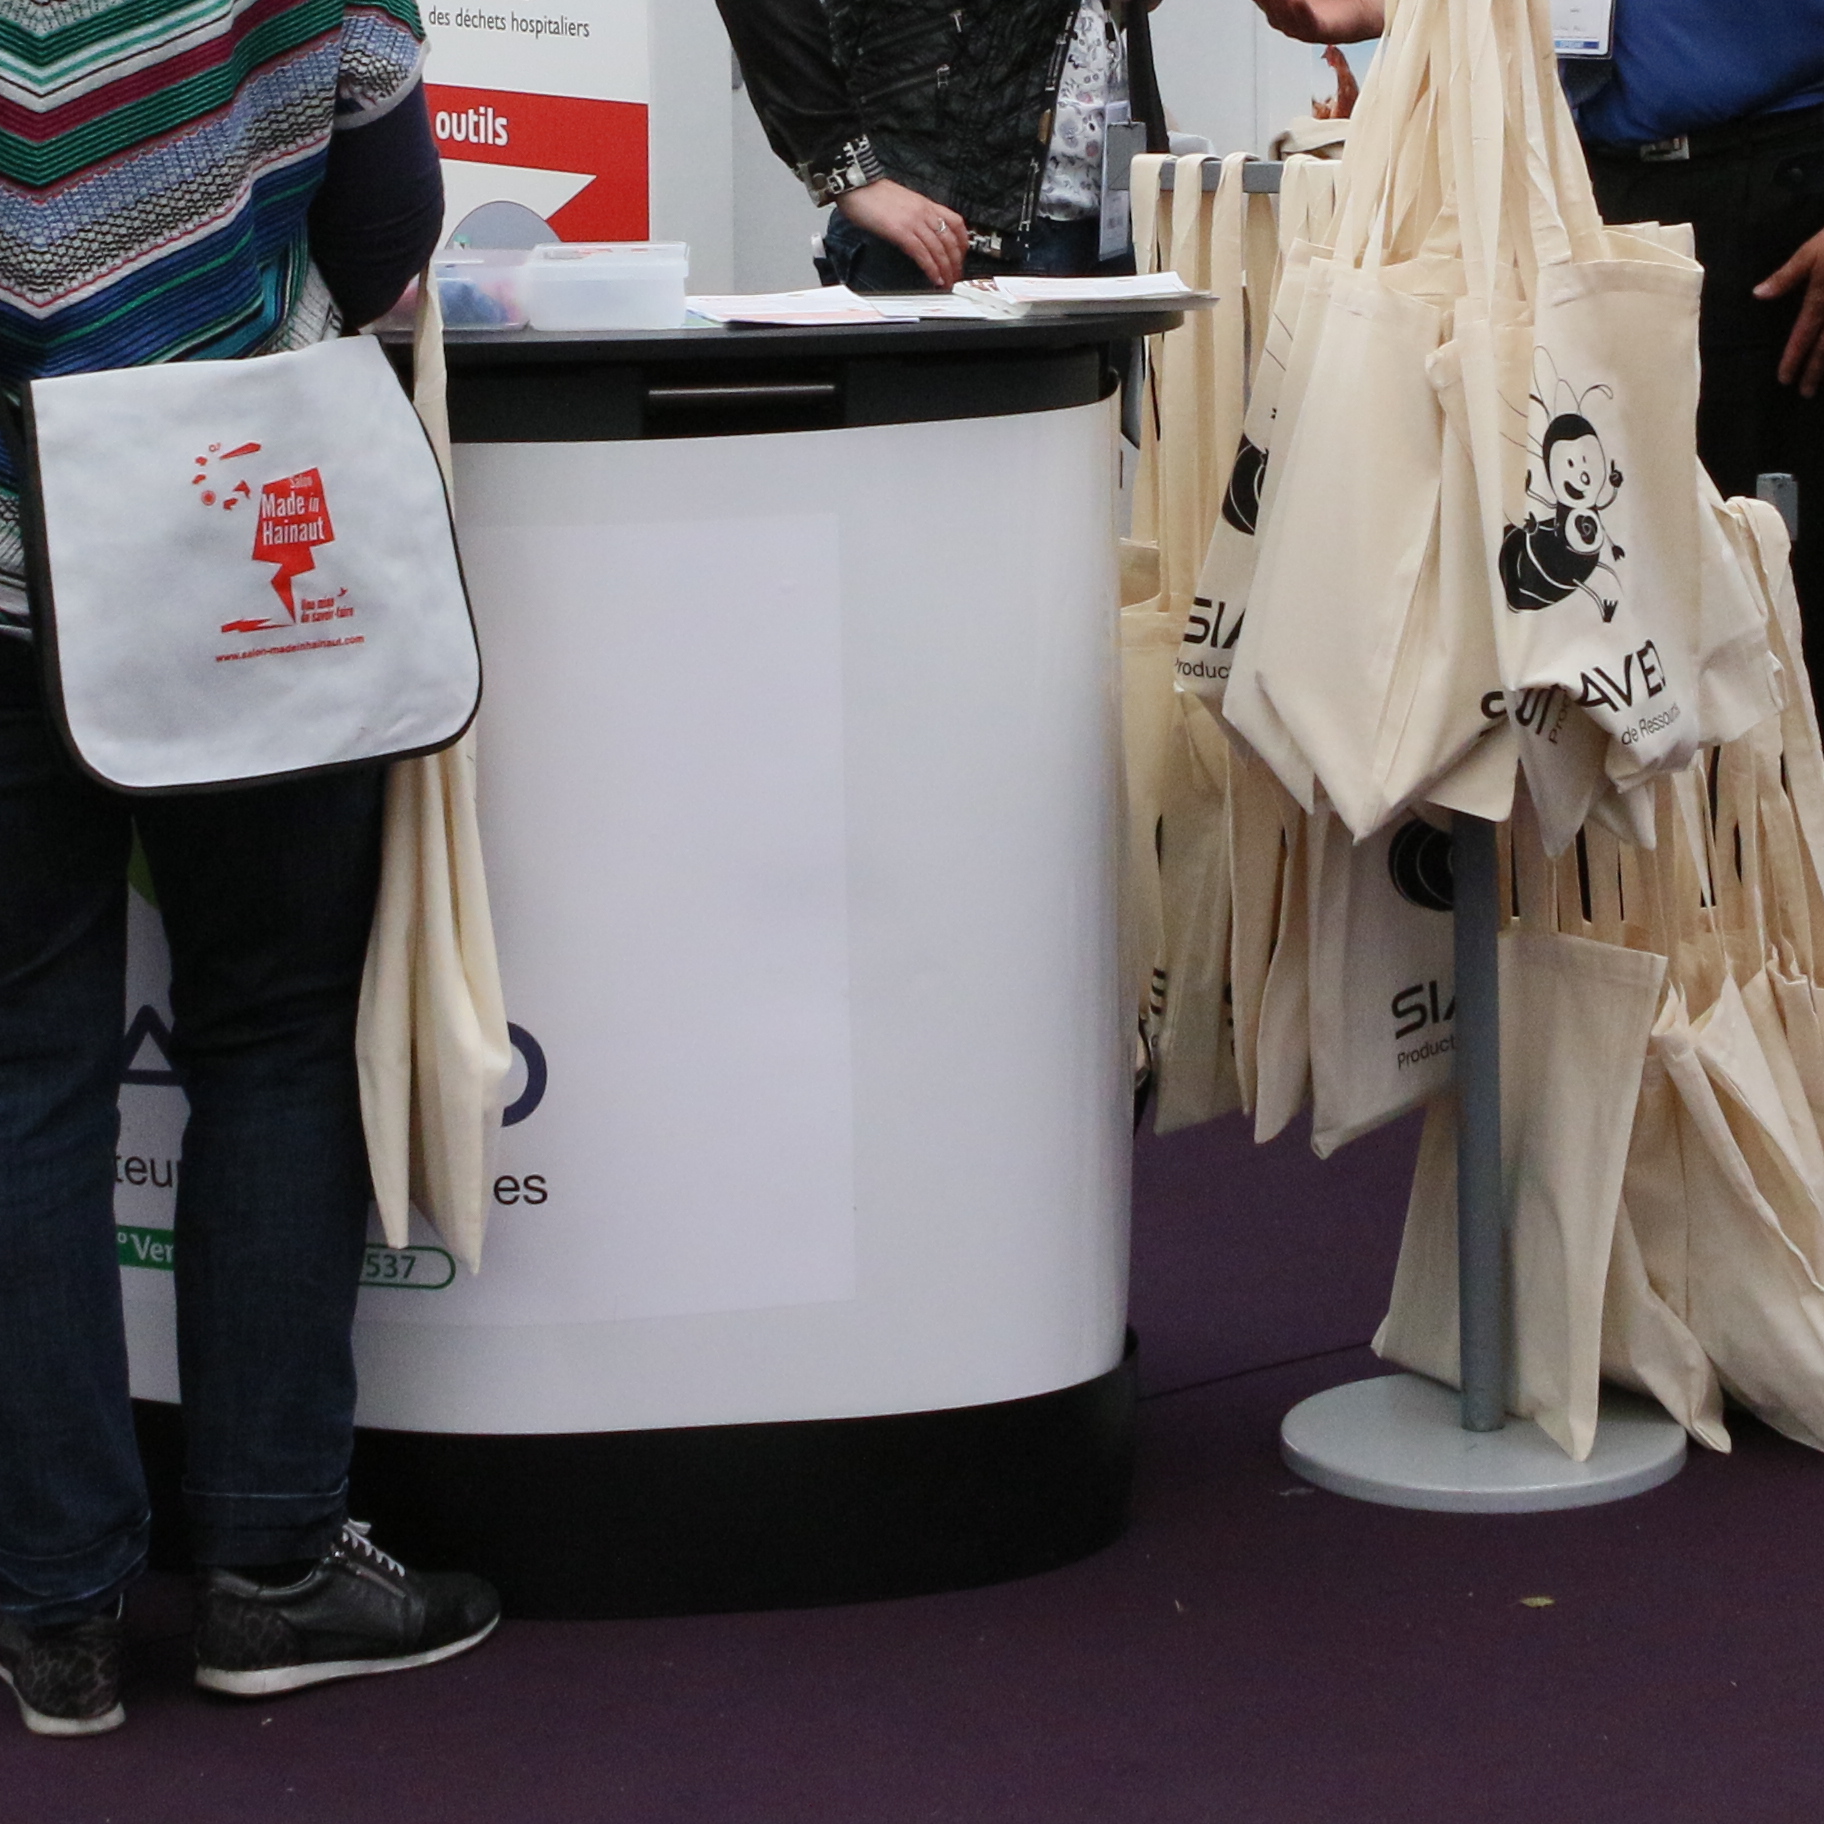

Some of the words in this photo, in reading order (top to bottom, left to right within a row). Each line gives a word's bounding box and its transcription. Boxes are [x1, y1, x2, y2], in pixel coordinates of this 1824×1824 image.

[428, 7, 452, 29] des
[454, 8, 507, 33] déchets
[510, 13, 591, 40] hospitaliers
[435, 106, 509, 147] outils
[262, 491, 306, 519] Made
[309, 492, 320, 513] in
[262, 517, 325, 546] Hainaut
